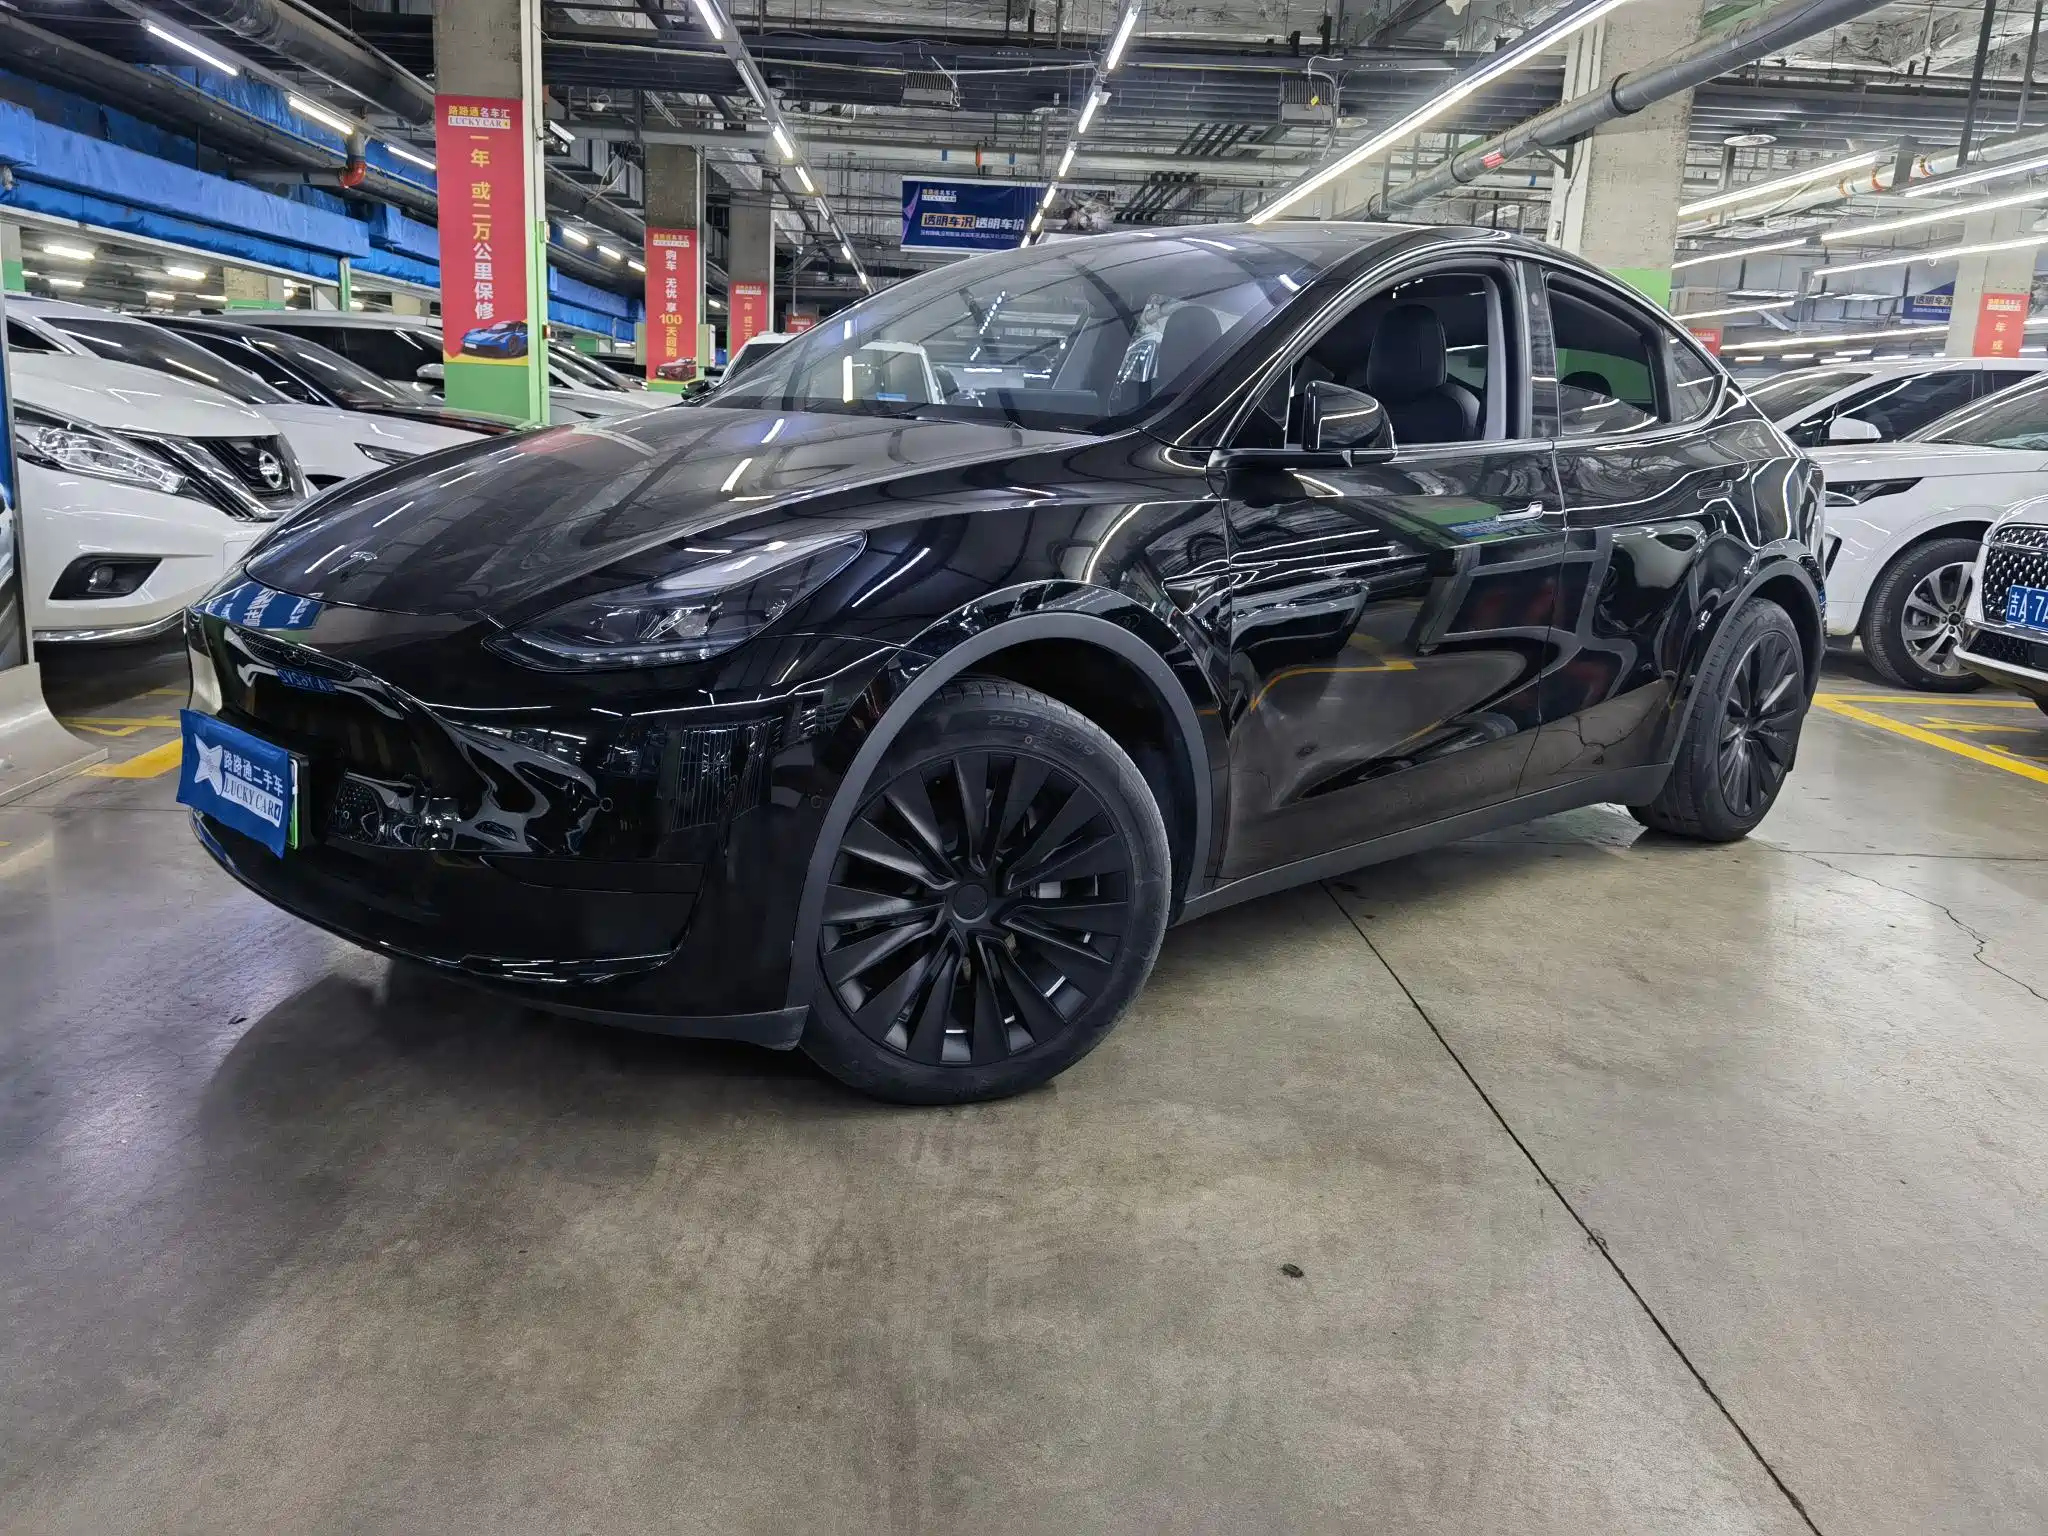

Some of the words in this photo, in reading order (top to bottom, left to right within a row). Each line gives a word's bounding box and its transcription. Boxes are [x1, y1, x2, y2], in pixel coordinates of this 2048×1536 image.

[449, 116, 482, 126] LUCKY
[470, 135, 494, 320] 一年或二万公里保修
[223, 750, 284, 797] 路路通二手车
[224, 777, 255, 805] LUCKY
[255, 793, 274, 817] CAR
